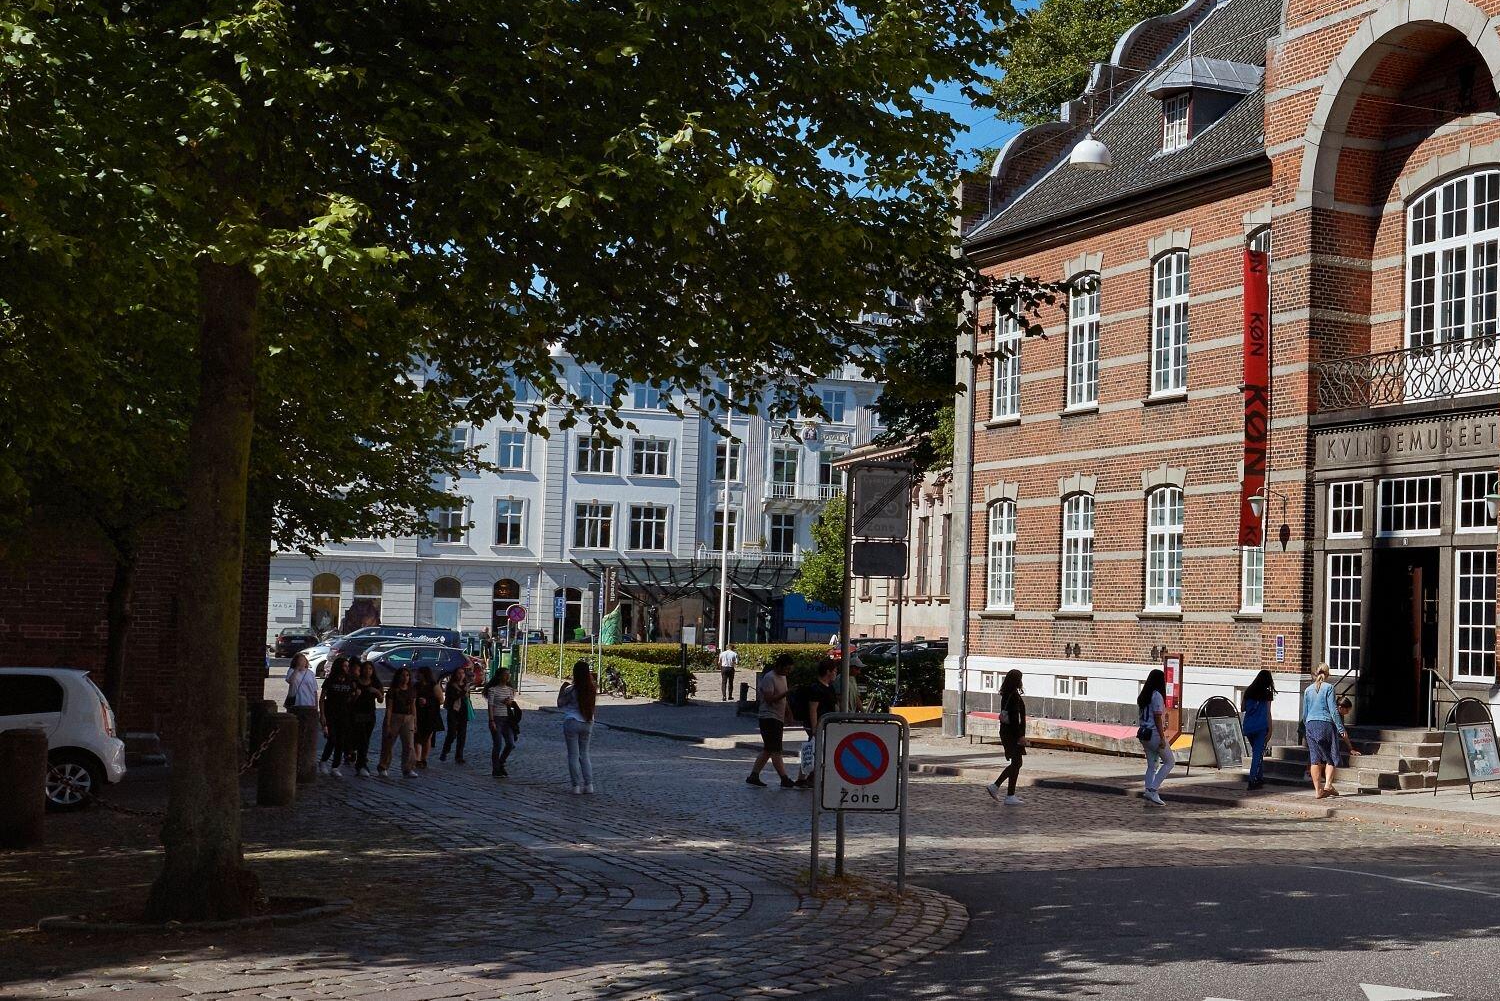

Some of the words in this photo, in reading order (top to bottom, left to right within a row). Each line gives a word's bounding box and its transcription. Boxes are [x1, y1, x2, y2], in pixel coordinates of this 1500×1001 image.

[1250, 312, 1264, 356] KØN
[1244, 384, 1268, 476] KØN
[1327, 422, 1497, 459] KVINDEMUSEET
[840, 790, 880, 804] Zone
